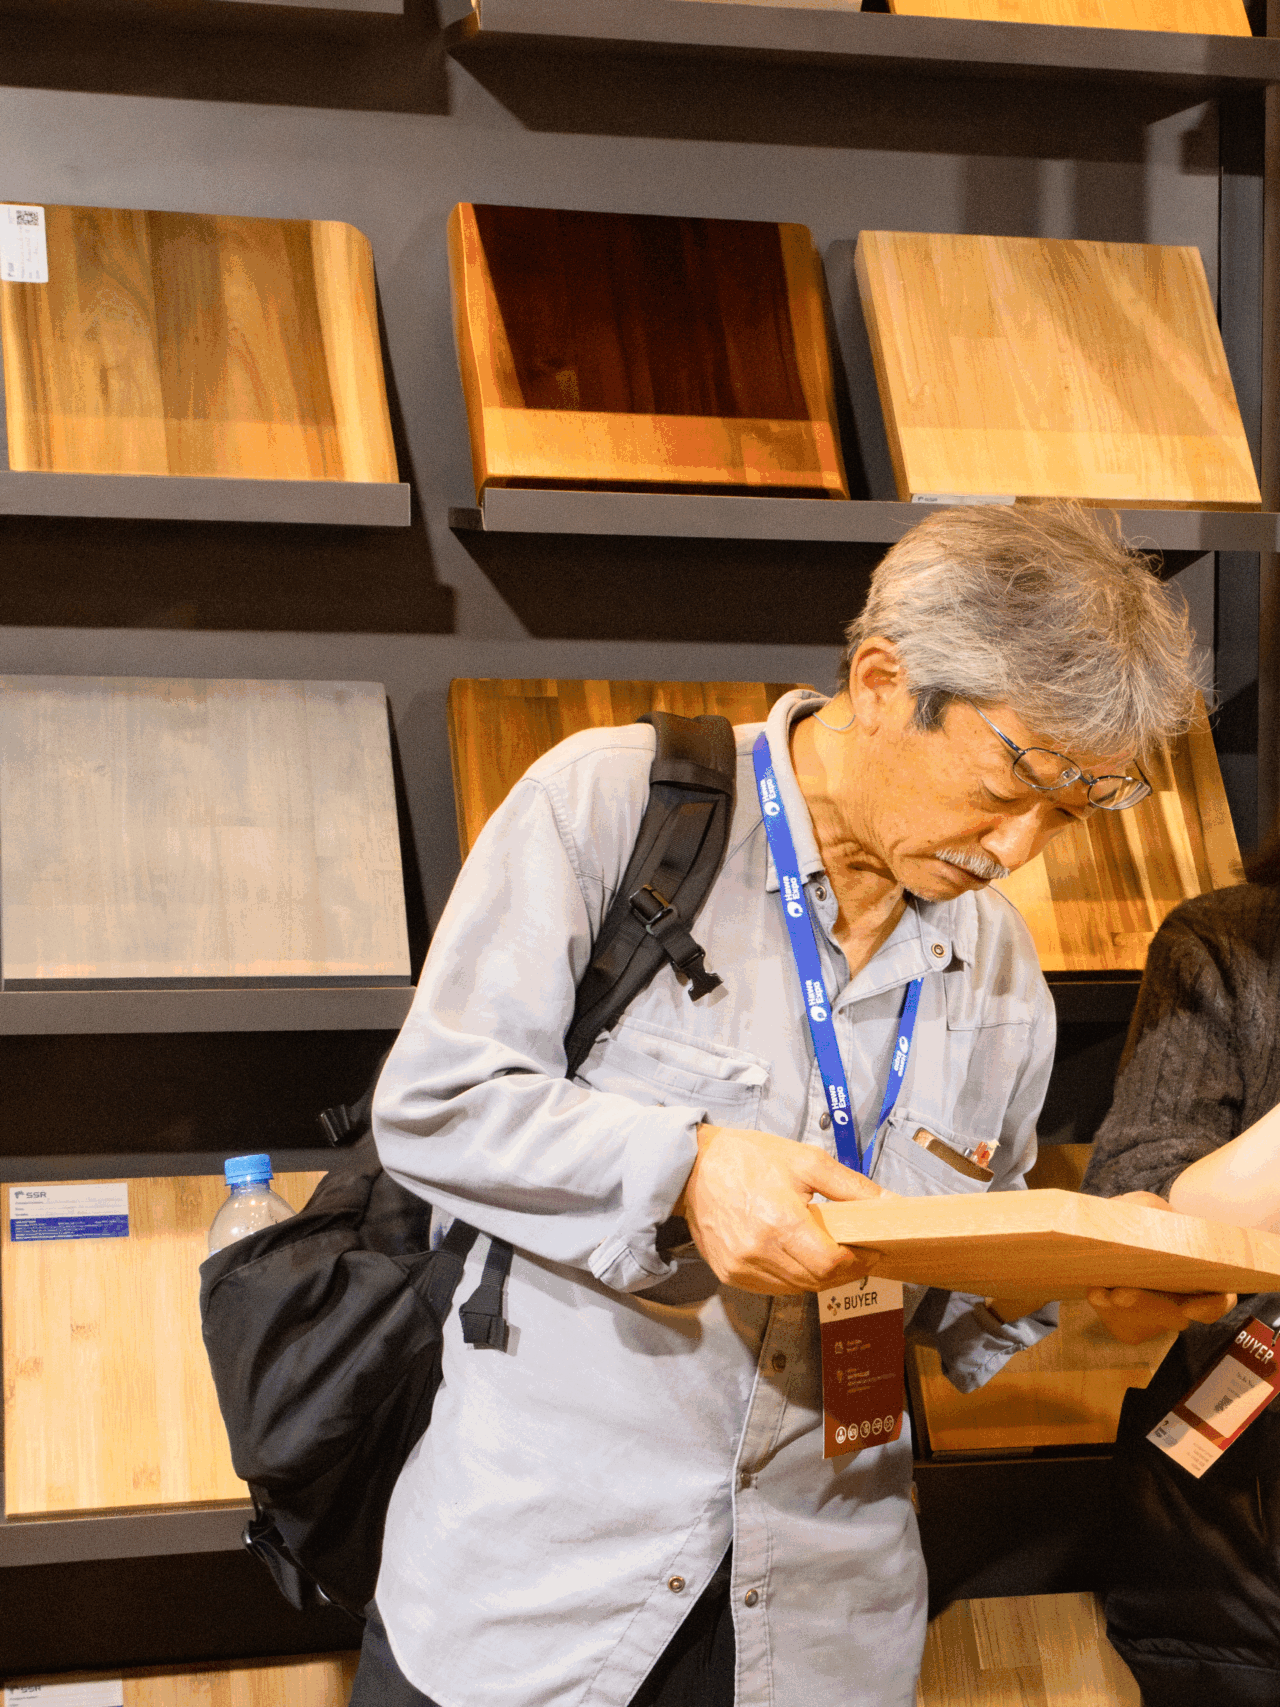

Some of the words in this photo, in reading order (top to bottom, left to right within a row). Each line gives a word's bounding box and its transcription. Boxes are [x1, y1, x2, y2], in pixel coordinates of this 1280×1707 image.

[766, 778, 777, 801] Expo
[783, 875, 791, 901] Hawa
[790, 877, 800, 900] Expo
[805, 980, 814, 1006] Hawa
[813, 981, 824, 1004] Expo
[829, 1085, 839, 1110] Hawa
[837, 1086, 846, 1109] Expo
[844, 1292, 878, 1310] BUYER
[1234, 1330, 1274, 1364] BUYER
